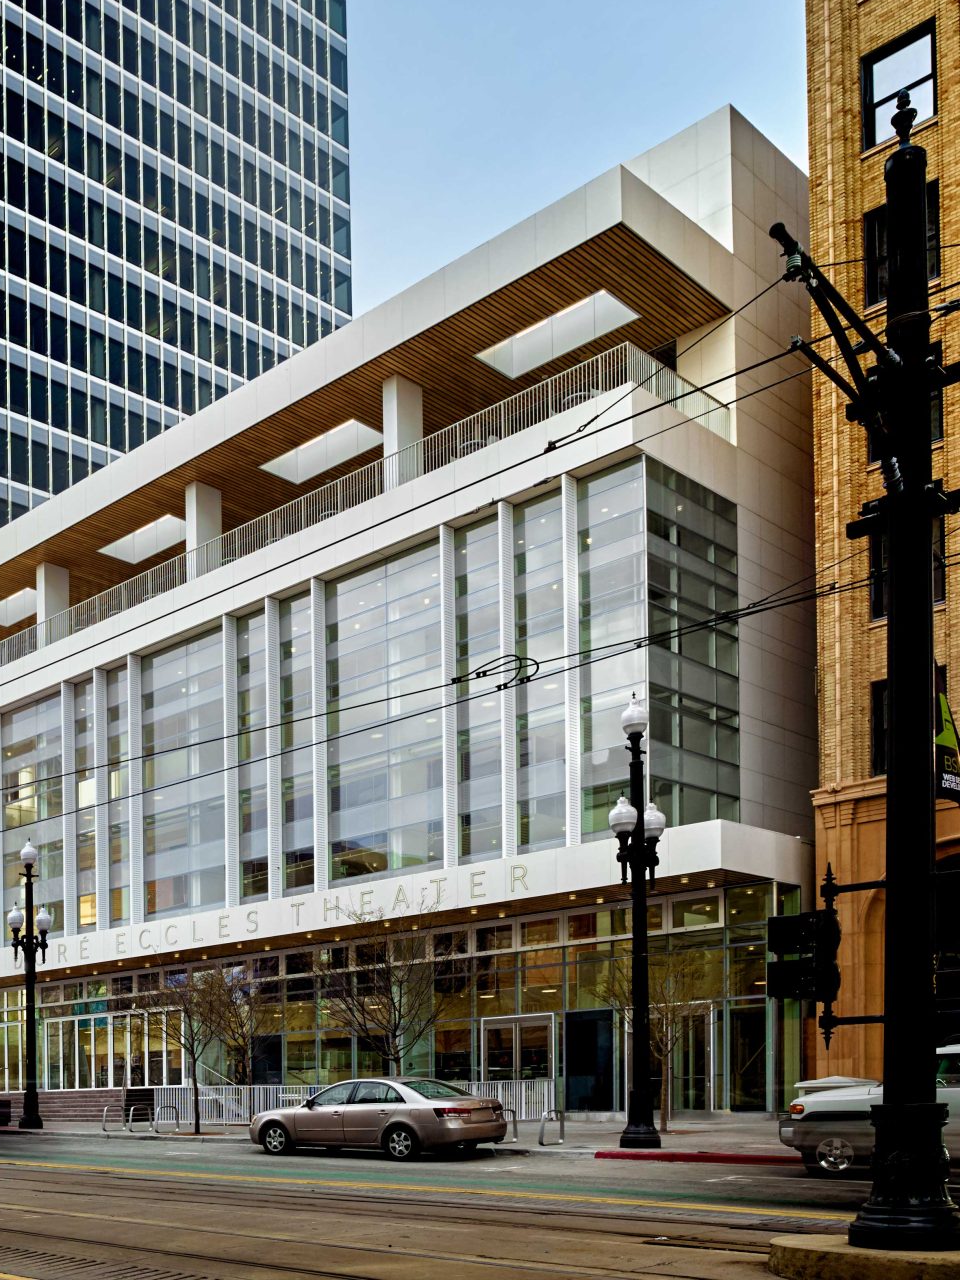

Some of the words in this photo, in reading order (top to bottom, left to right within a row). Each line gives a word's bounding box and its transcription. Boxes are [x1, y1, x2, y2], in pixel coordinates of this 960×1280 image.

[14, 936, 90, 970] DRÉ
[115, 910, 259, 955] ECCLES
[290, 864, 529, 927] THEATER
